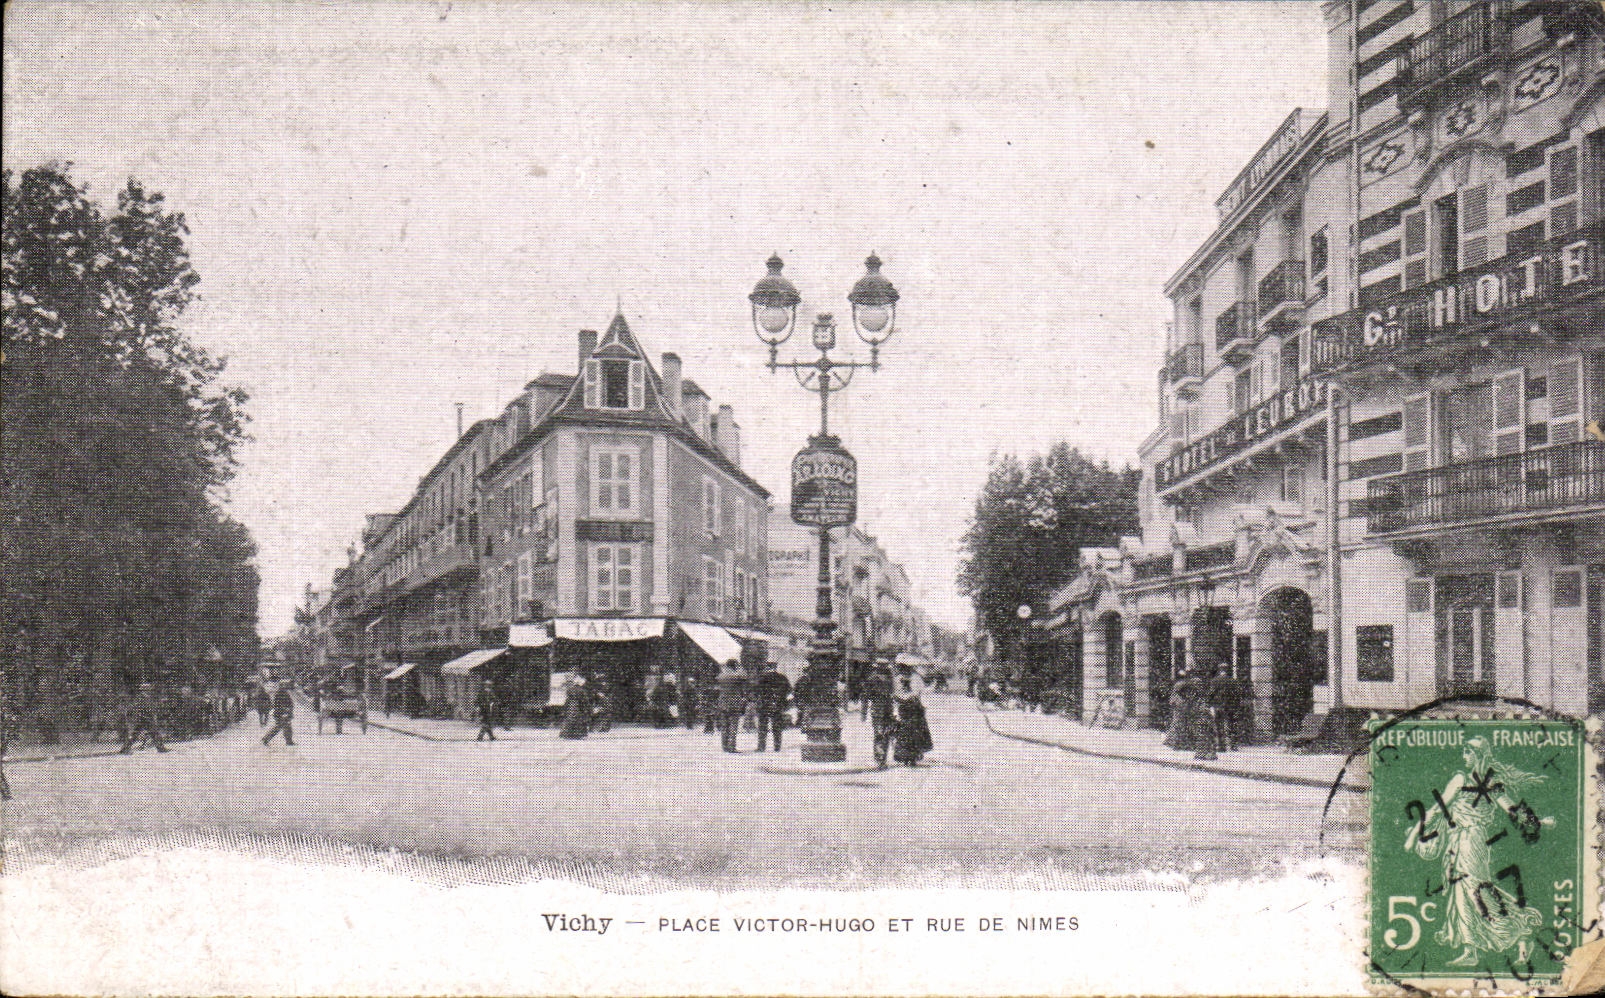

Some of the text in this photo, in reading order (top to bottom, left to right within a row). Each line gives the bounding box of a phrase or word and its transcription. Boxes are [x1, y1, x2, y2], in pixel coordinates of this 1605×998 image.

[569, 621, 648, 638] TABAC
[1493, 729, 1575, 749] FRANÇAISE
[1553, 879, 1573, 961] POSTES
